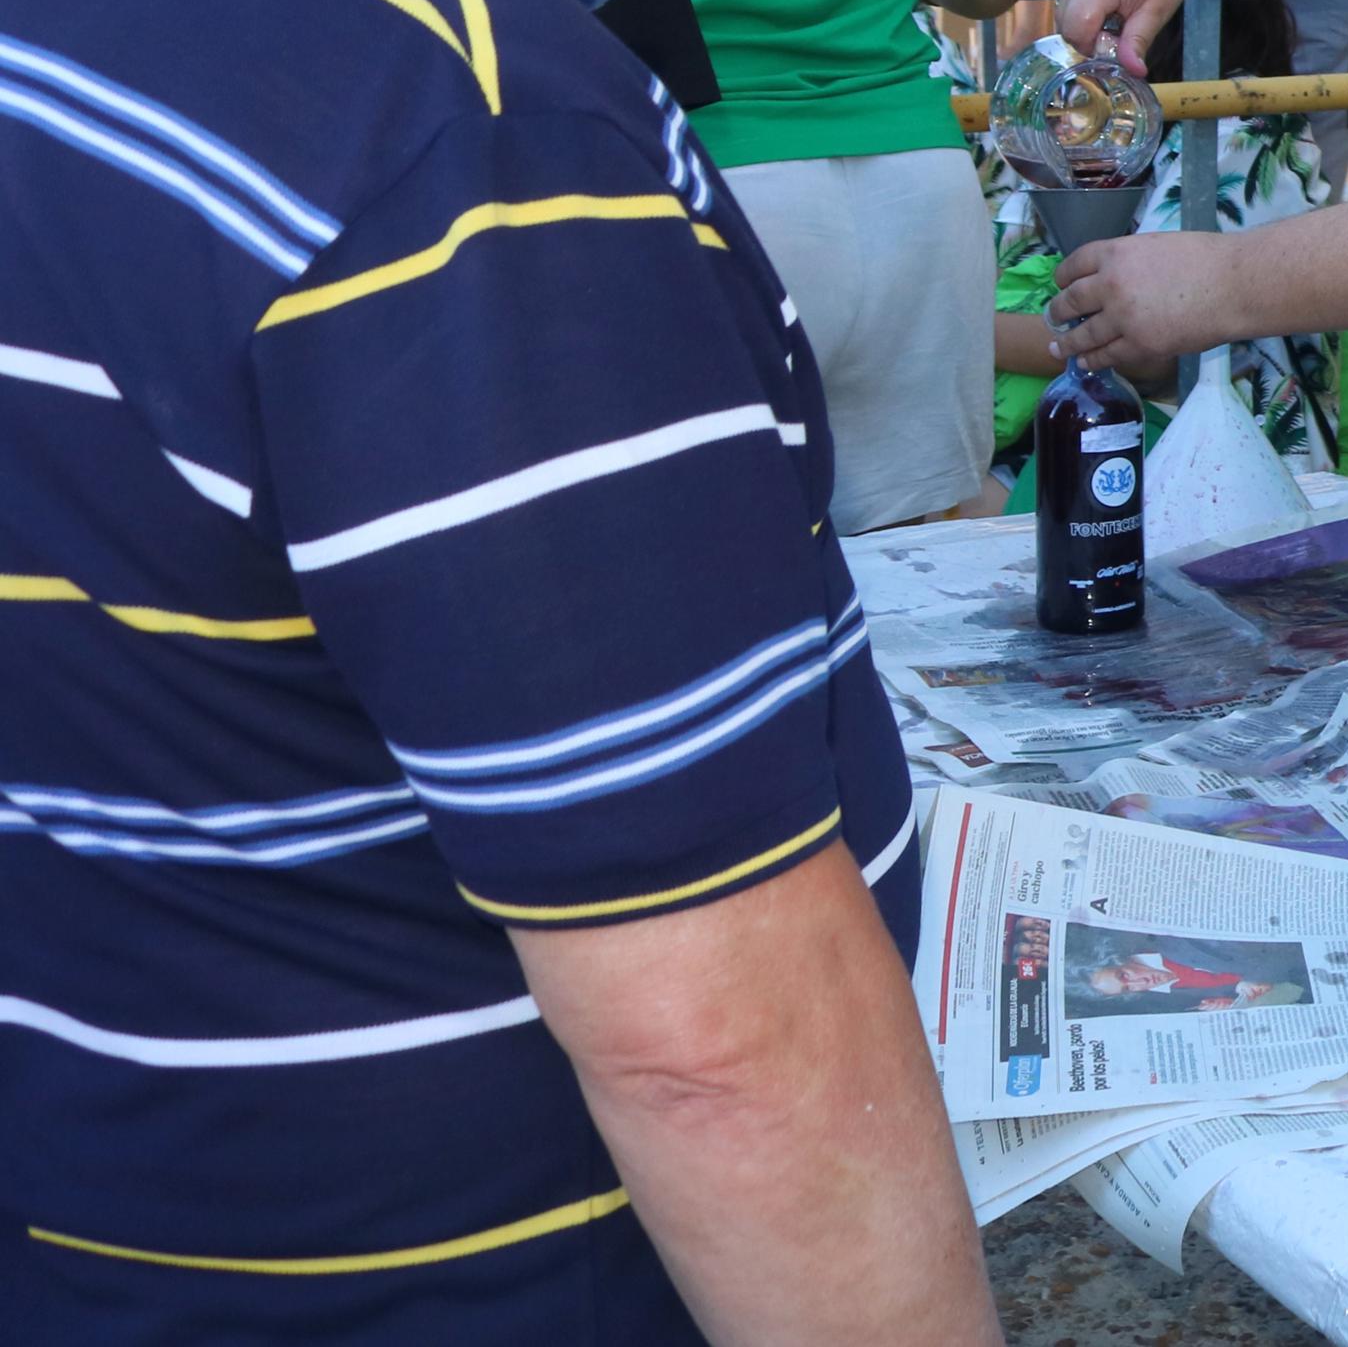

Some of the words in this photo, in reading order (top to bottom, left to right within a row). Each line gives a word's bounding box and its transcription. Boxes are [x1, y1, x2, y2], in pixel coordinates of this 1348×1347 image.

[1017, 878, 1028, 902] Giro
[1031, 860, 1045, 904] cachopo
[1066, 1024, 1085, 1048] ¿sordo
[1089, 1040, 1109, 1063] pelos?
[1067, 1048, 1085, 1092] Beethoven,
[1090, 1063, 1106, 1077] los
[1094, 1076, 1111, 1091] por
[1113, 1183, 1142, 1217] AGENDA
